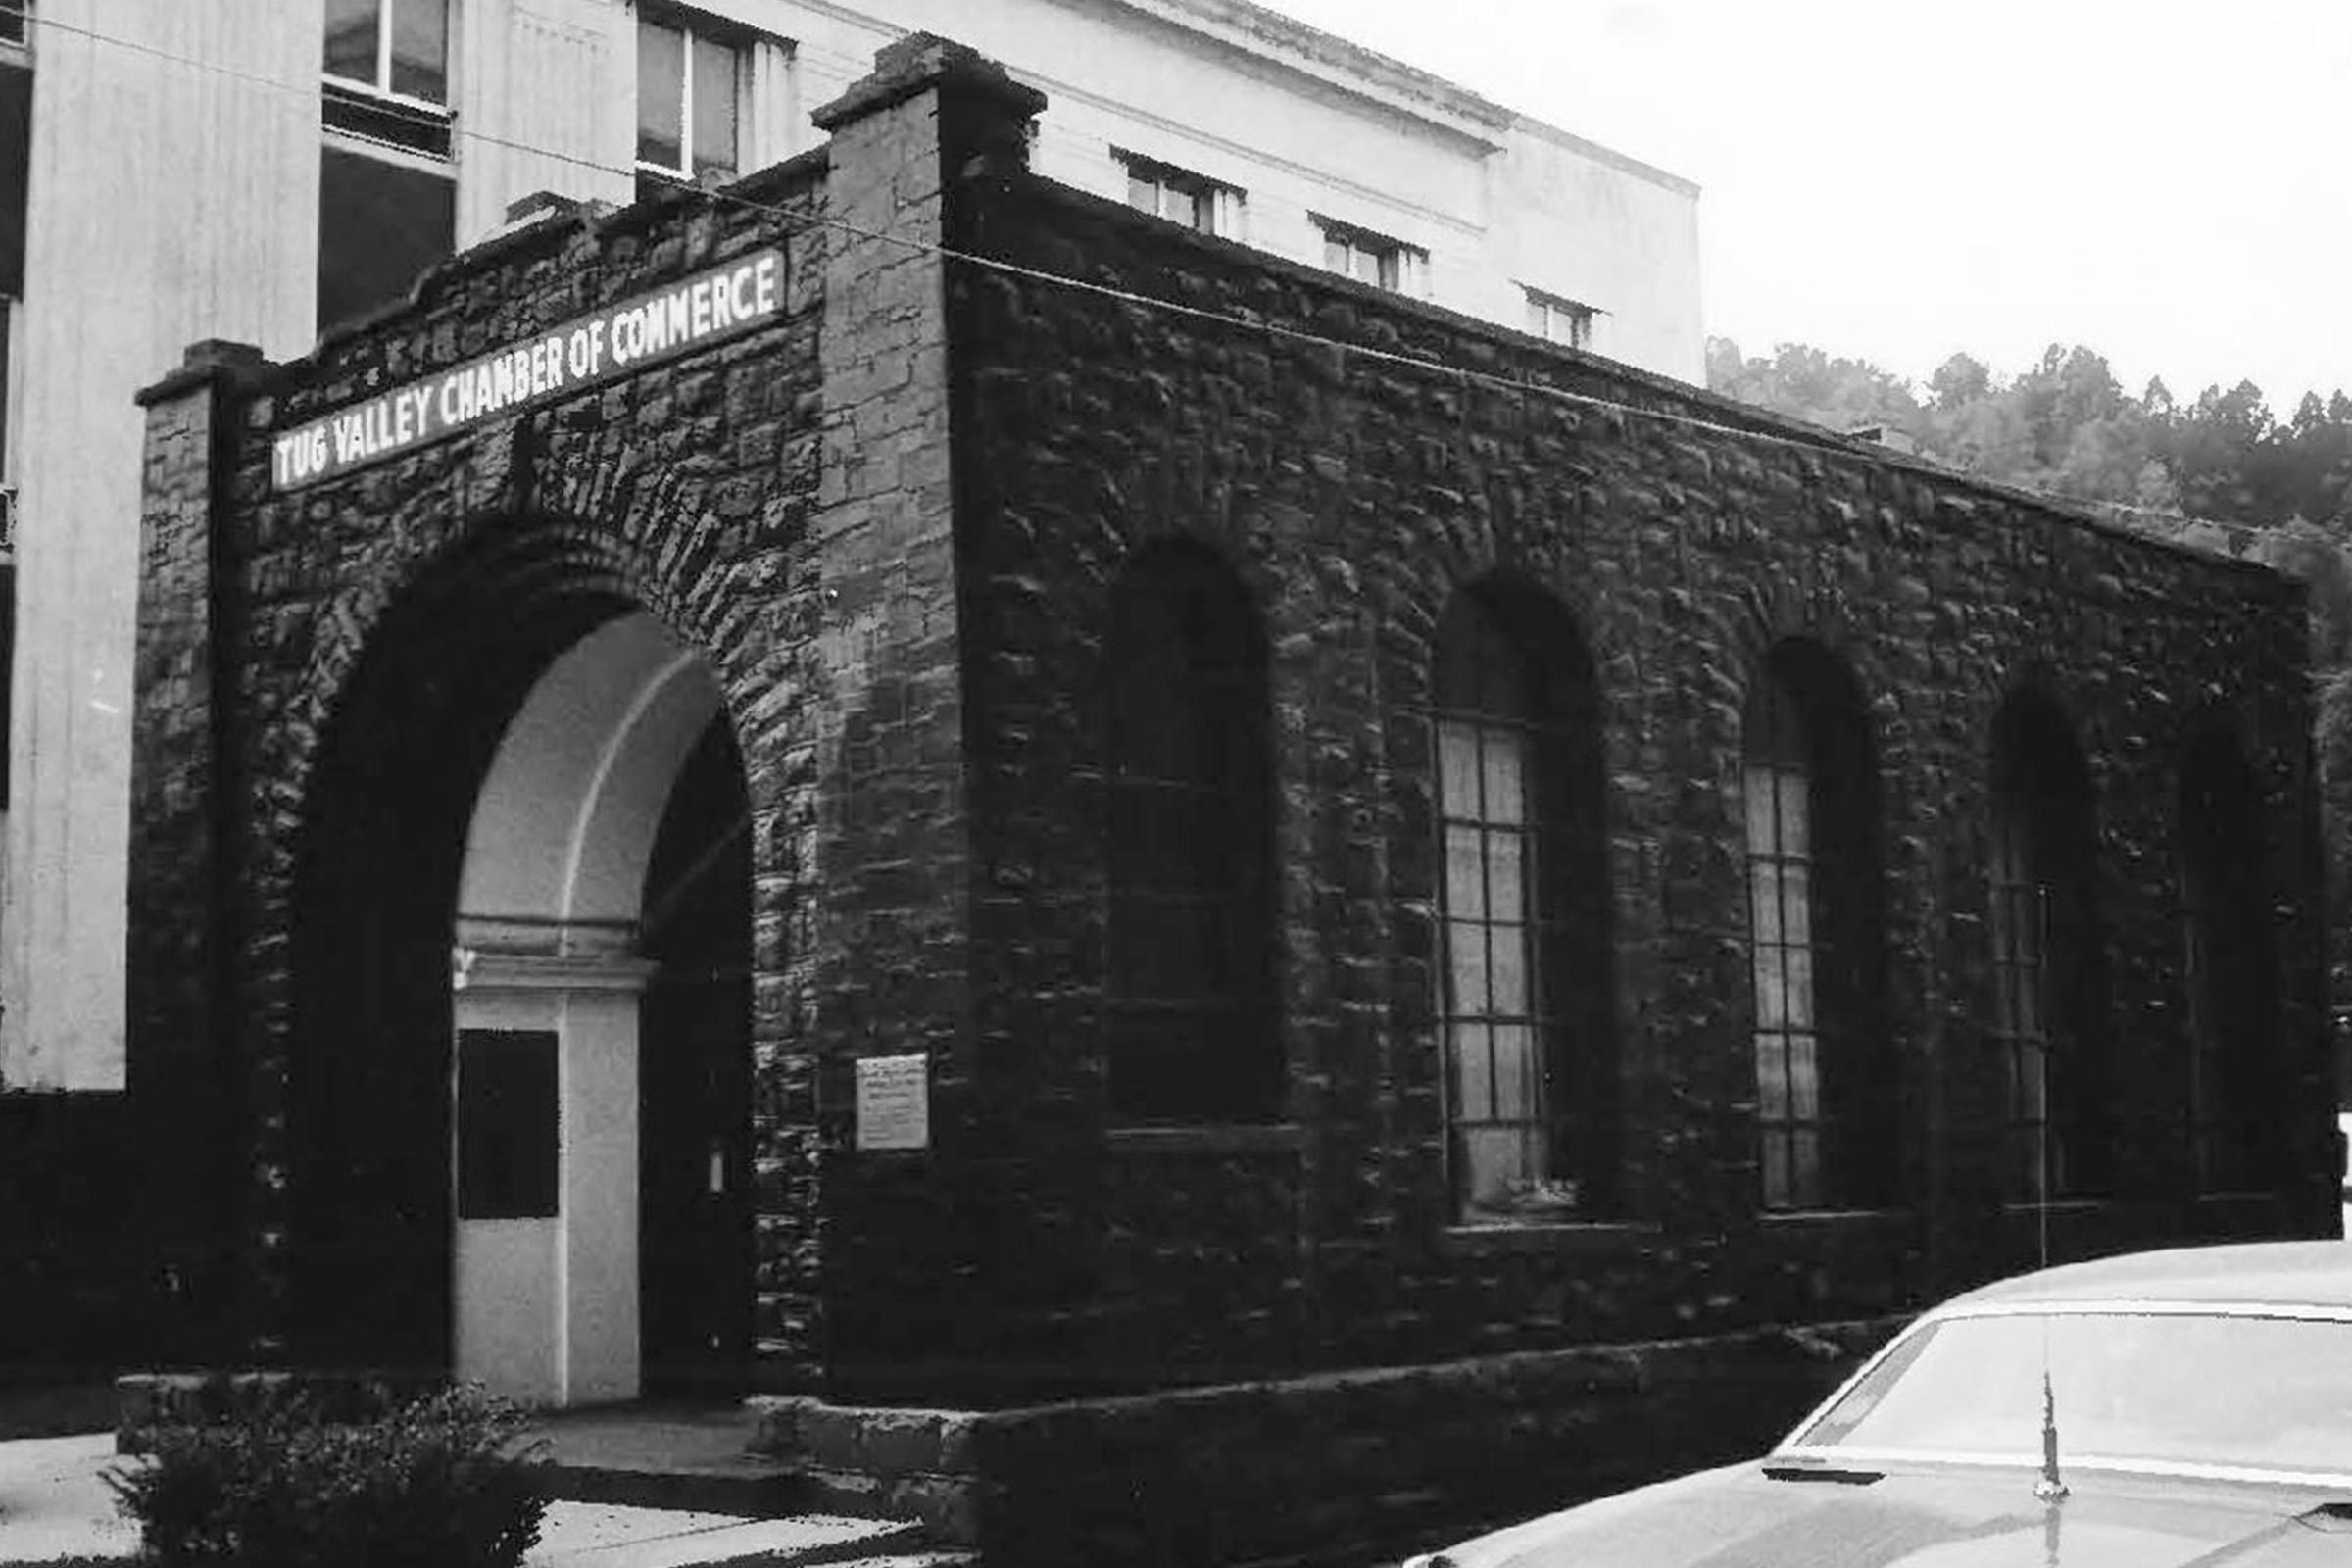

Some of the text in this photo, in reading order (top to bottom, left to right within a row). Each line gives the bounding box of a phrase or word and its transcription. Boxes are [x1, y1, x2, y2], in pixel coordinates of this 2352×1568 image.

[276, 256, 775, 485] TUG VALLEY CHAMBER OF COMMERCE
